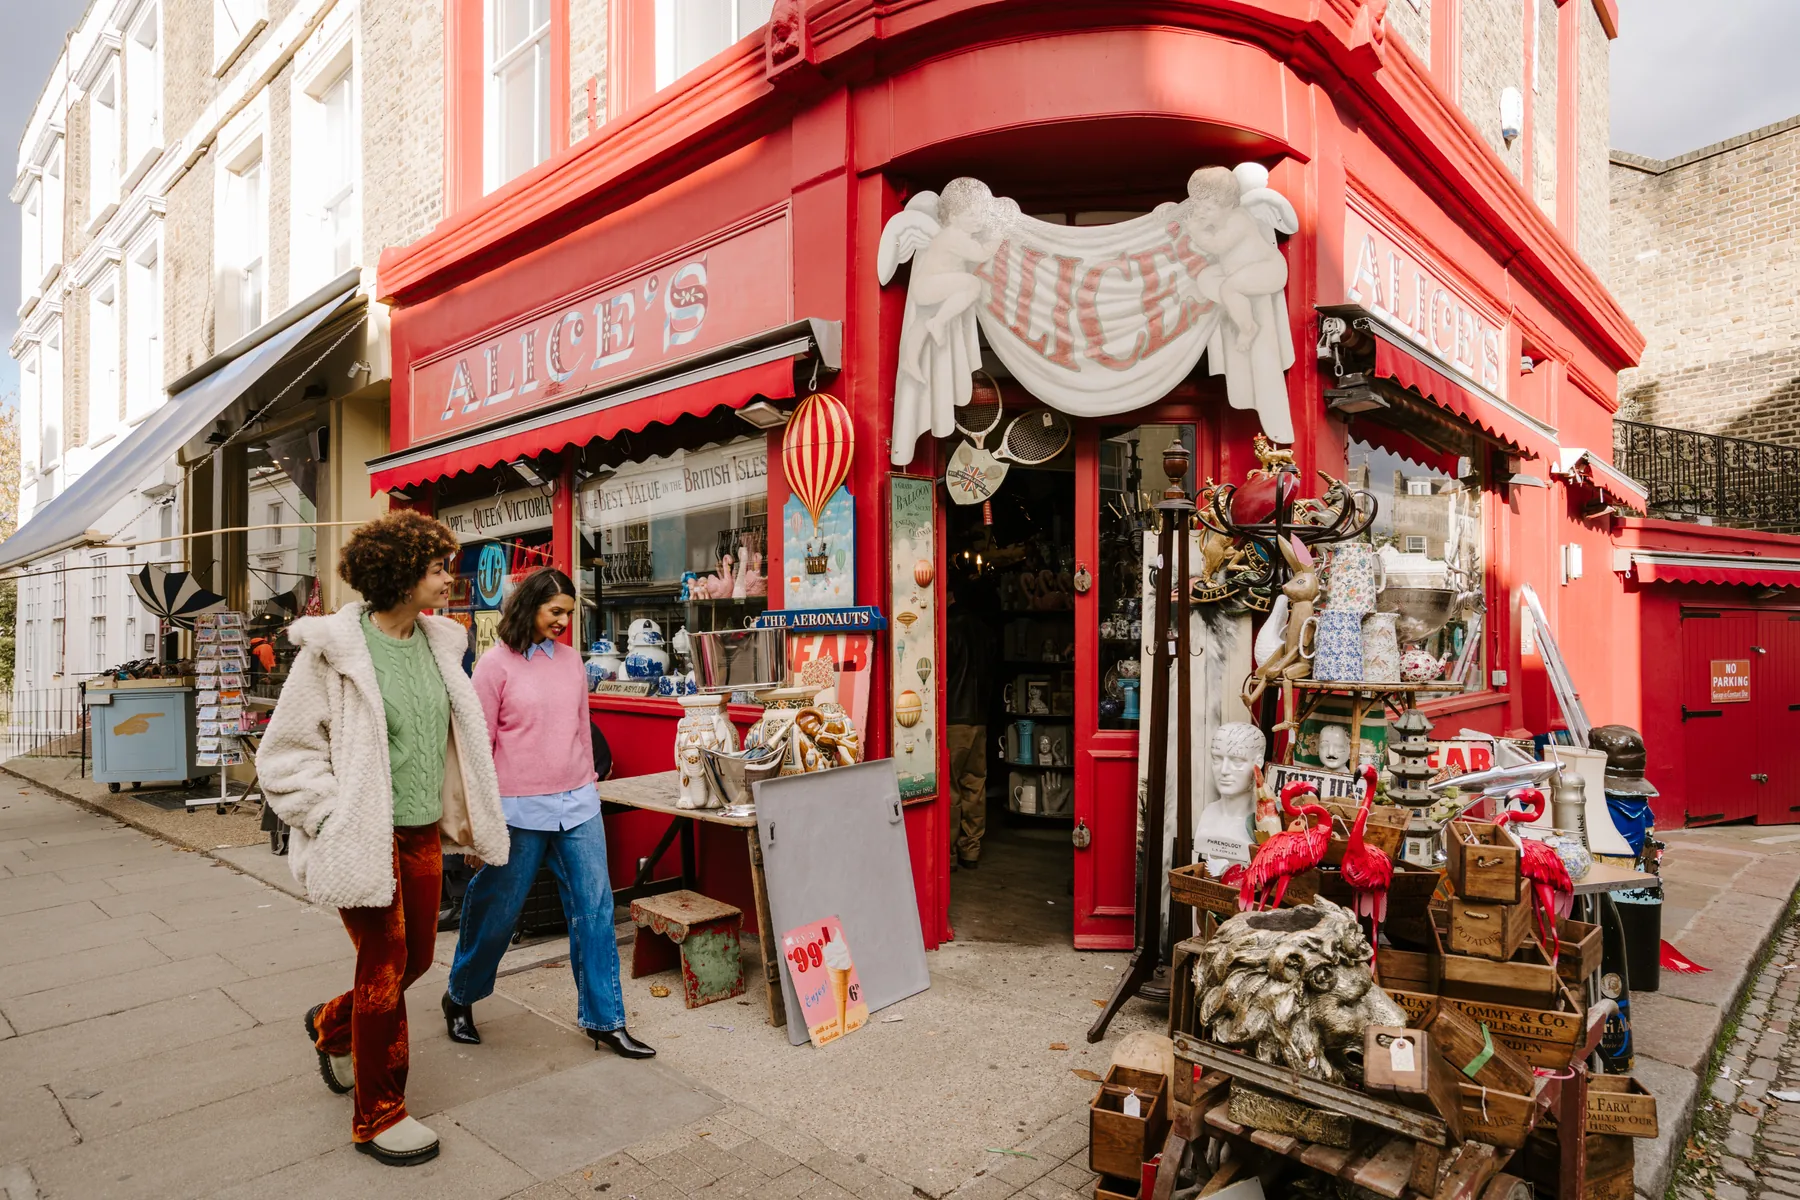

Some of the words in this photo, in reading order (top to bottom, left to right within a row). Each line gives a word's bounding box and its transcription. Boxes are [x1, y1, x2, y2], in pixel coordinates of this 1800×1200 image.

[1348, 232, 1500, 392] ALICE'S
[441, 253, 709, 420] ALICE'S
[598, 489, 624, 512] BEST
[625, 481, 661, 504] VALUE
[682, 463, 731, 493] BRITISH
[733, 455, 768, 481] ISLES
[472, 507, 503, 534] QUEEN
[504, 495, 553, 523] VICTORIA
[762, 614, 788, 628] THE
[792, 610, 870, 627] AERONAUTS
[793, 633, 869, 673] FAB
[1726, 663, 1737, 674] NO
[1713, 676, 1749, 687] PARKING
[1455, 925, 1501, 947] POTATOES
[805, 980, 829, 1008] Enjoy!
[1453, 1000, 1517, 1022] TOMMY
[1519, 1012, 1533, 1024] &
[1502, 1038, 1543, 1053] RDEN
[1614, 1115, 1626, 1124] BY
[1628, 1115, 1653, 1126] OUR
